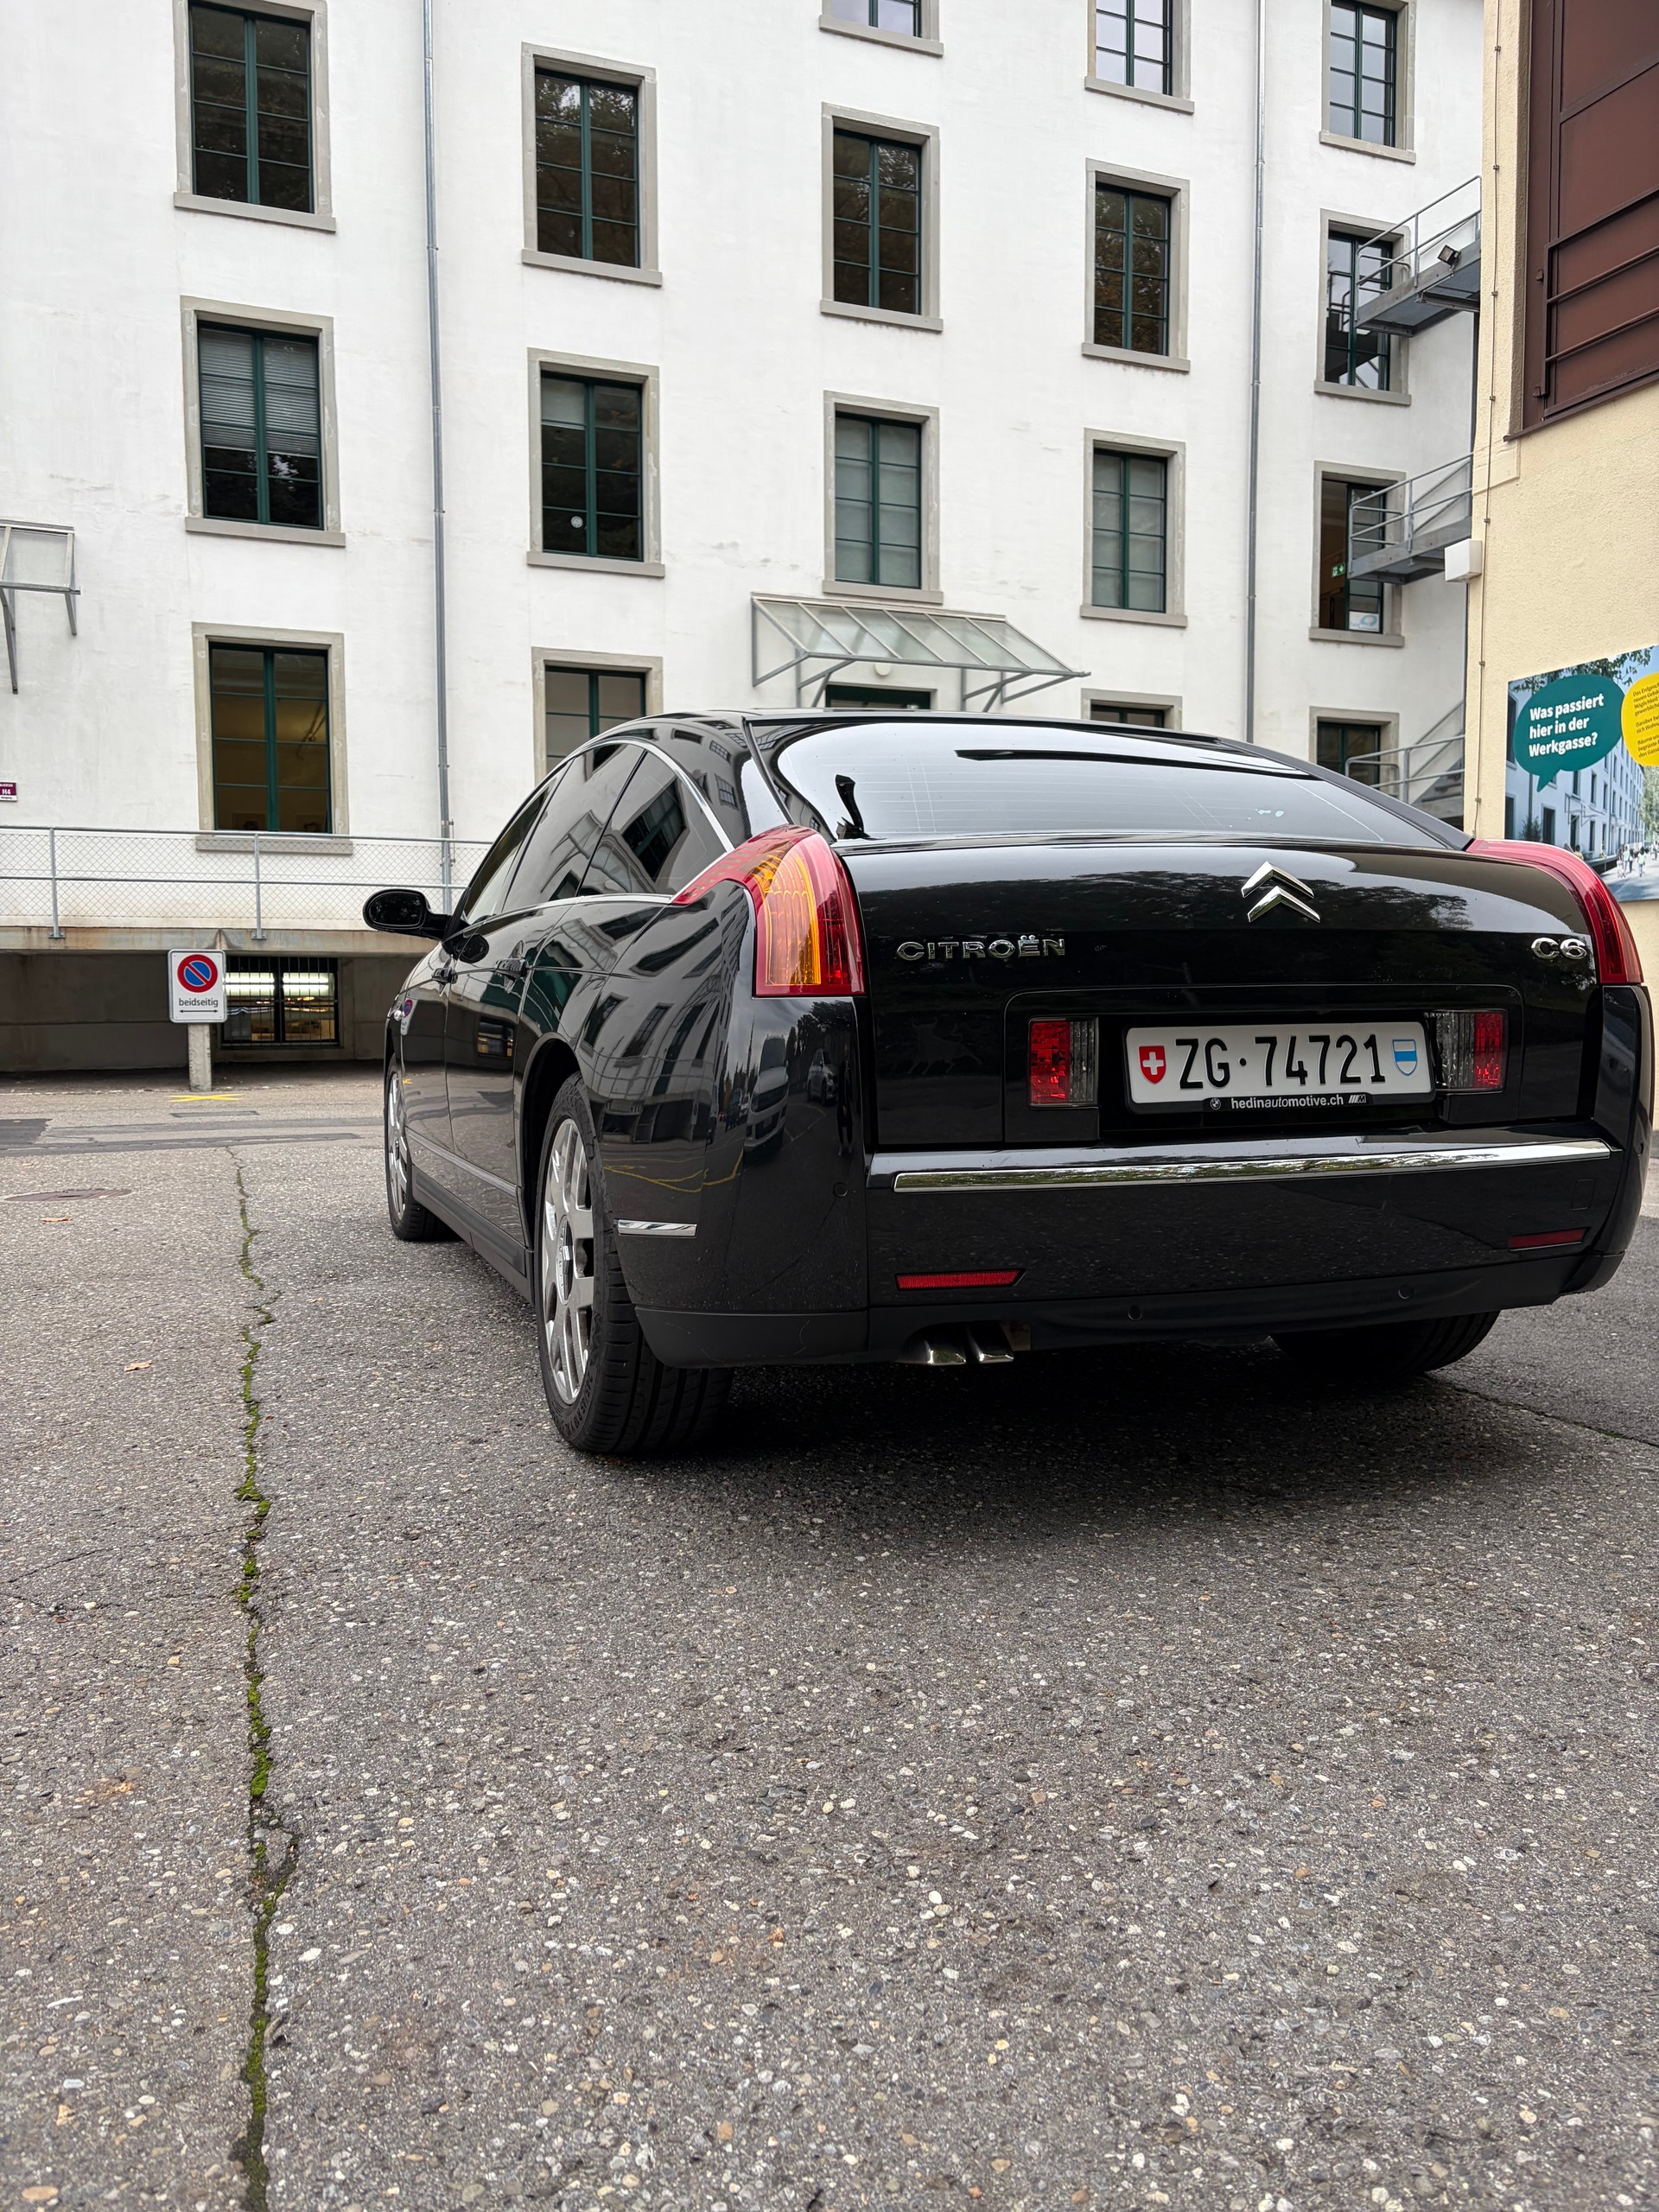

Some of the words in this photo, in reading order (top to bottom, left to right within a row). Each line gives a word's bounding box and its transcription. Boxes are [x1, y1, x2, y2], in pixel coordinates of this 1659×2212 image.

[1530, 707, 1554, 721] Was
[1554, 693, 1605, 719] passiert
[1529, 724, 1554, 740] hier
[1554, 720, 1567, 734] in
[1568, 716, 1590, 732] der
[1529, 732, 1599, 757] Werkgasse?
[897, 934, 1065, 961] CITROËN
[1530, 937, 1587, 960] C6
[178, 997, 219, 1007] beidseitig
[1230, 1094, 1344, 1109] hedinautomotive.ch
